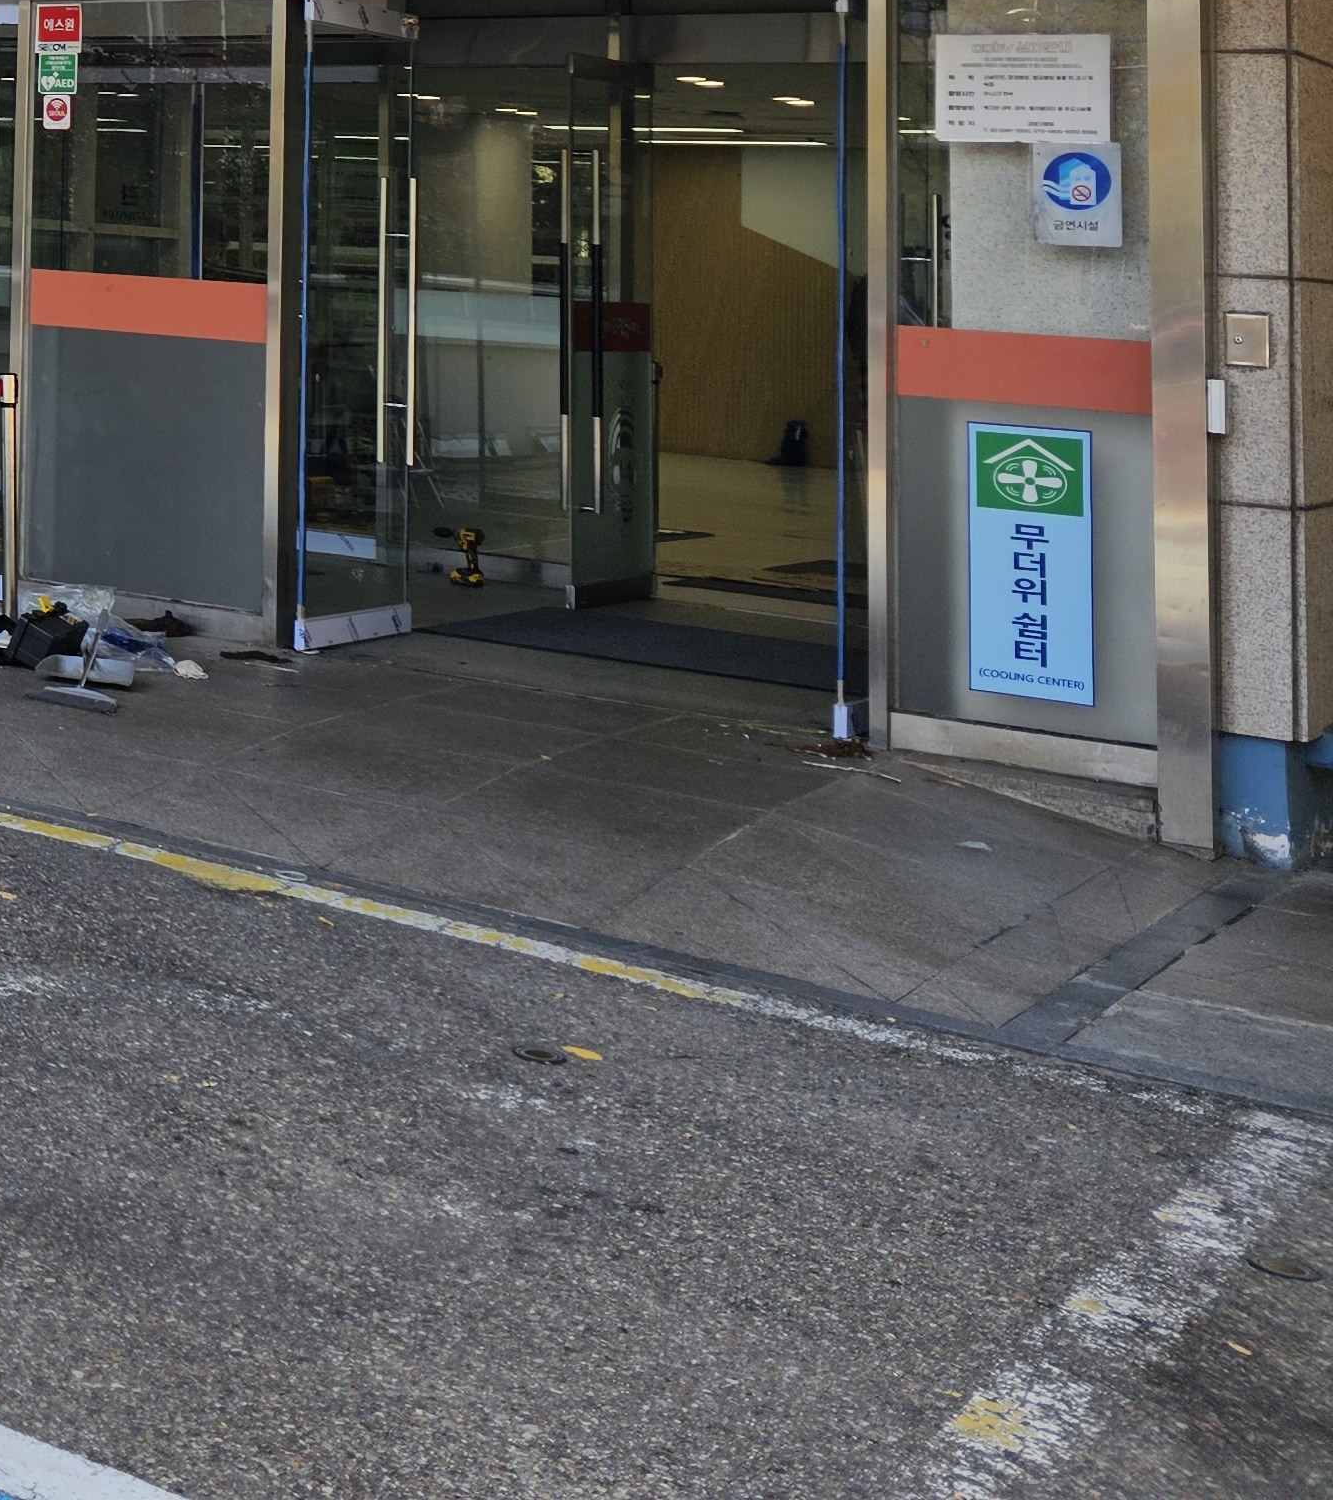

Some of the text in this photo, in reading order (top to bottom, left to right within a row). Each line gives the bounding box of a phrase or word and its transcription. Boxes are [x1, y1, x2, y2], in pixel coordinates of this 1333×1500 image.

[43, 17, 75, 32] 에스원
[37, 43, 66, 51] SECOM
[55, 78, 75, 88] AED
[1053, 220, 1099, 232] 금연시설
[1010, 523, 1050, 669] 무더위 쉼터
[979, 667, 1085, 691] (COOLING CENTER)
